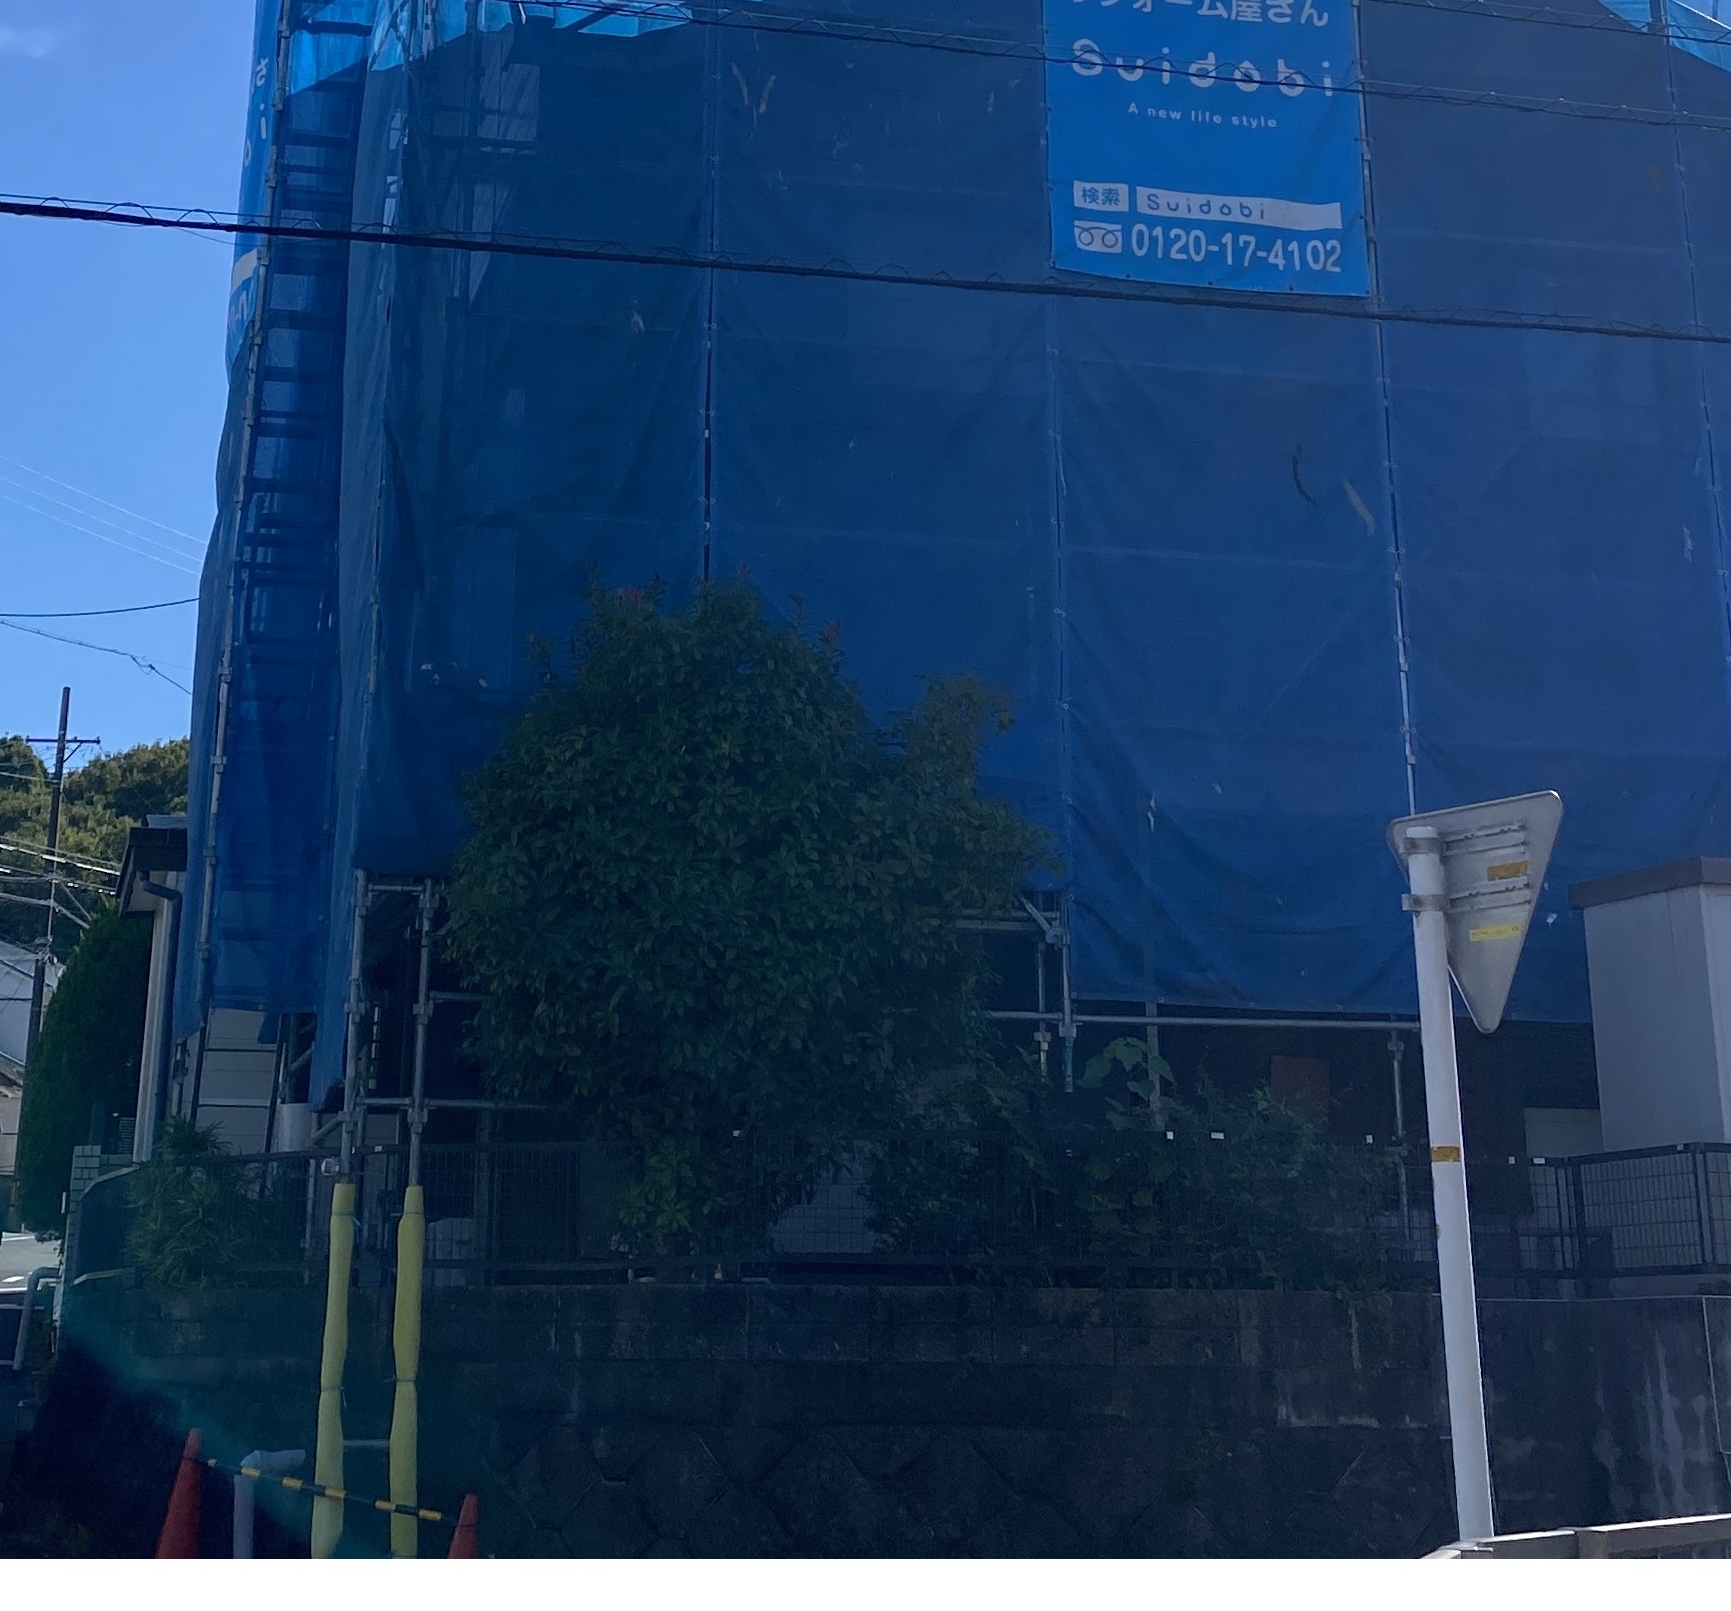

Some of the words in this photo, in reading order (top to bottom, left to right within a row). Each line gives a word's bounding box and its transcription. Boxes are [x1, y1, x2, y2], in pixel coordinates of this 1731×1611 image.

[1071, 38, 1333, 97] Suidobi
[1128, 102, 1139, 115] A
[1147, 108, 1182, 121] new
[1191, 110, 1222, 125] life
[1232, 113, 1277, 129] style
[1081, 186, 1121, 206] 検索
[1147, 193, 1266, 220] Suidobi
[1131, 223, 1342, 273] 0120-17-4102
